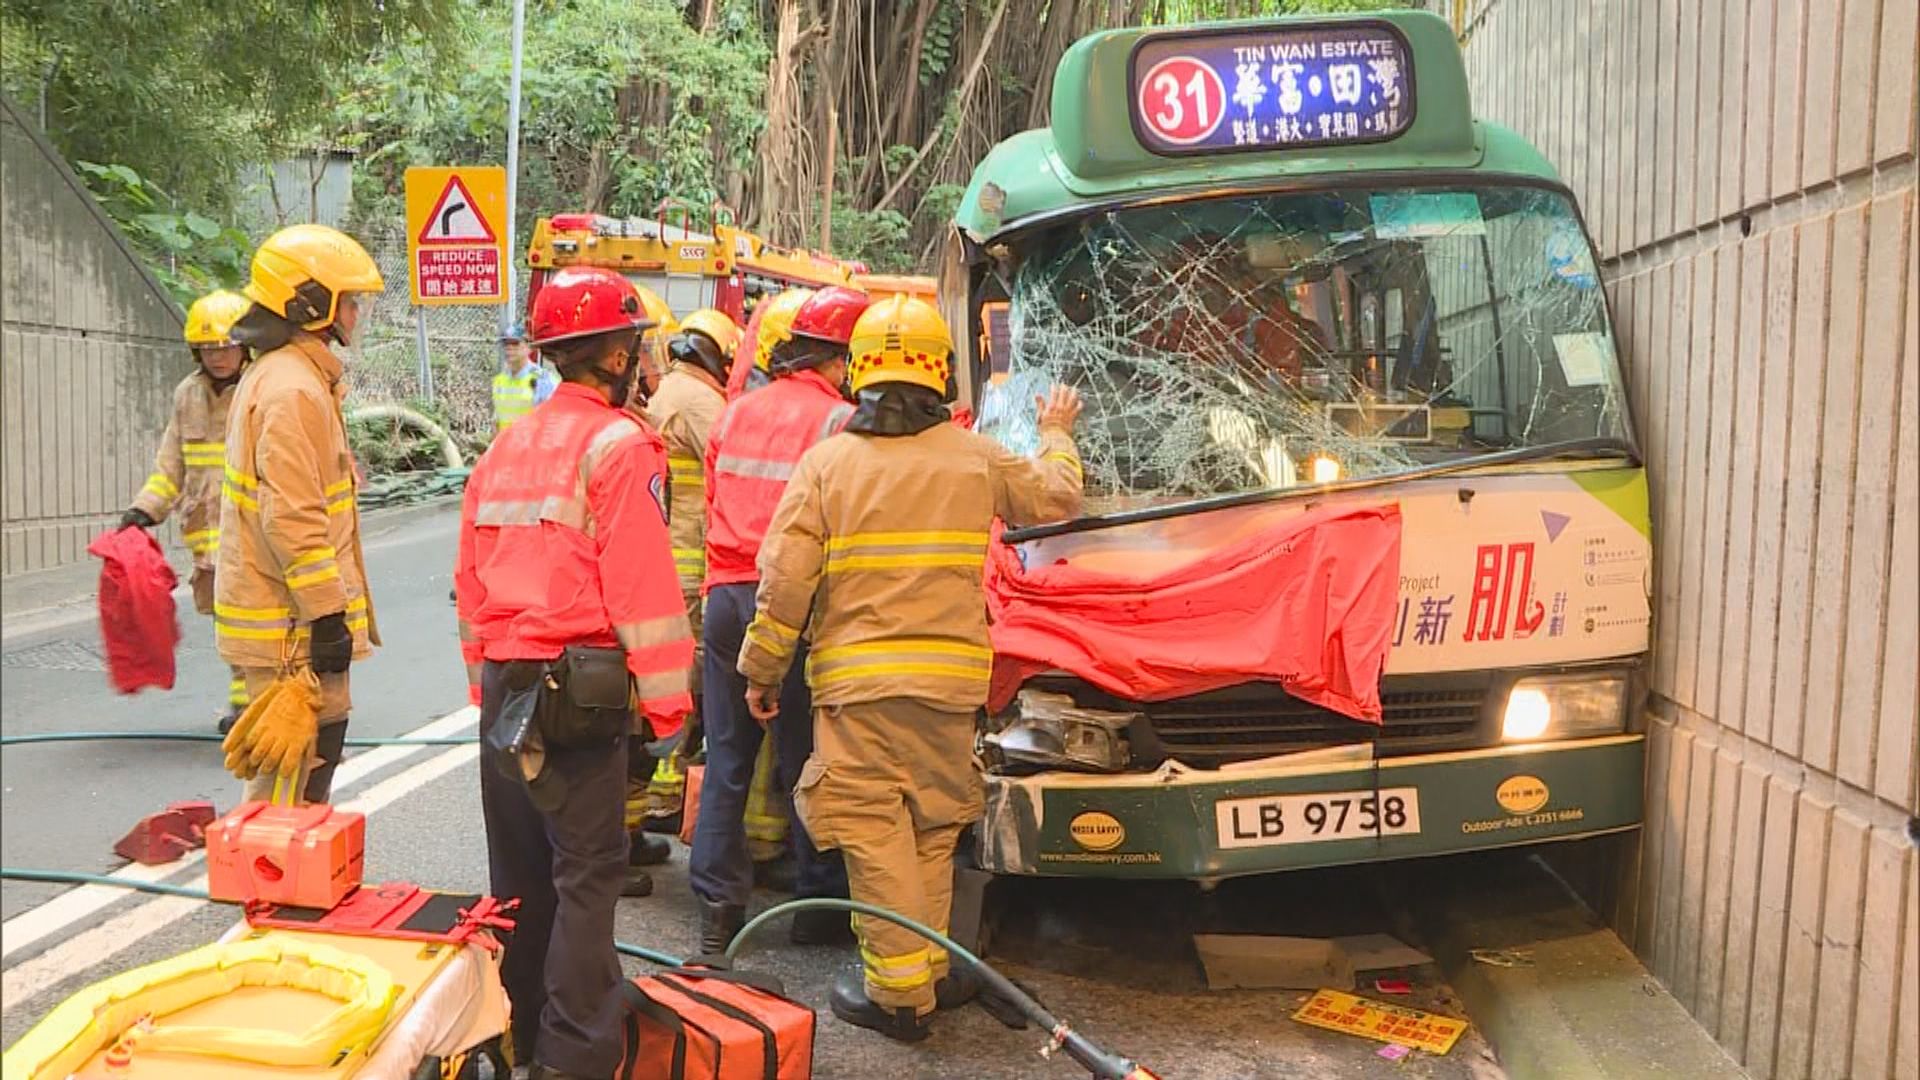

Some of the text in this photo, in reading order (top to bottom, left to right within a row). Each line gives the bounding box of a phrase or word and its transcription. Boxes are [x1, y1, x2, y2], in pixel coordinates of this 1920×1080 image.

[1233, 40, 1394, 62] TIN WAN ESTATE
[1154, 69, 1209, 131] 31
[432, 251, 485, 262] REDUCE
[421, 263, 496, 276] SPEED NOW
[425, 279, 493, 296] 開始減速
[1399, 575, 1440, 593] Project
[1231, 796, 1407, 839] LB 9758
[1462, 820, 1503, 834] Outdoor
